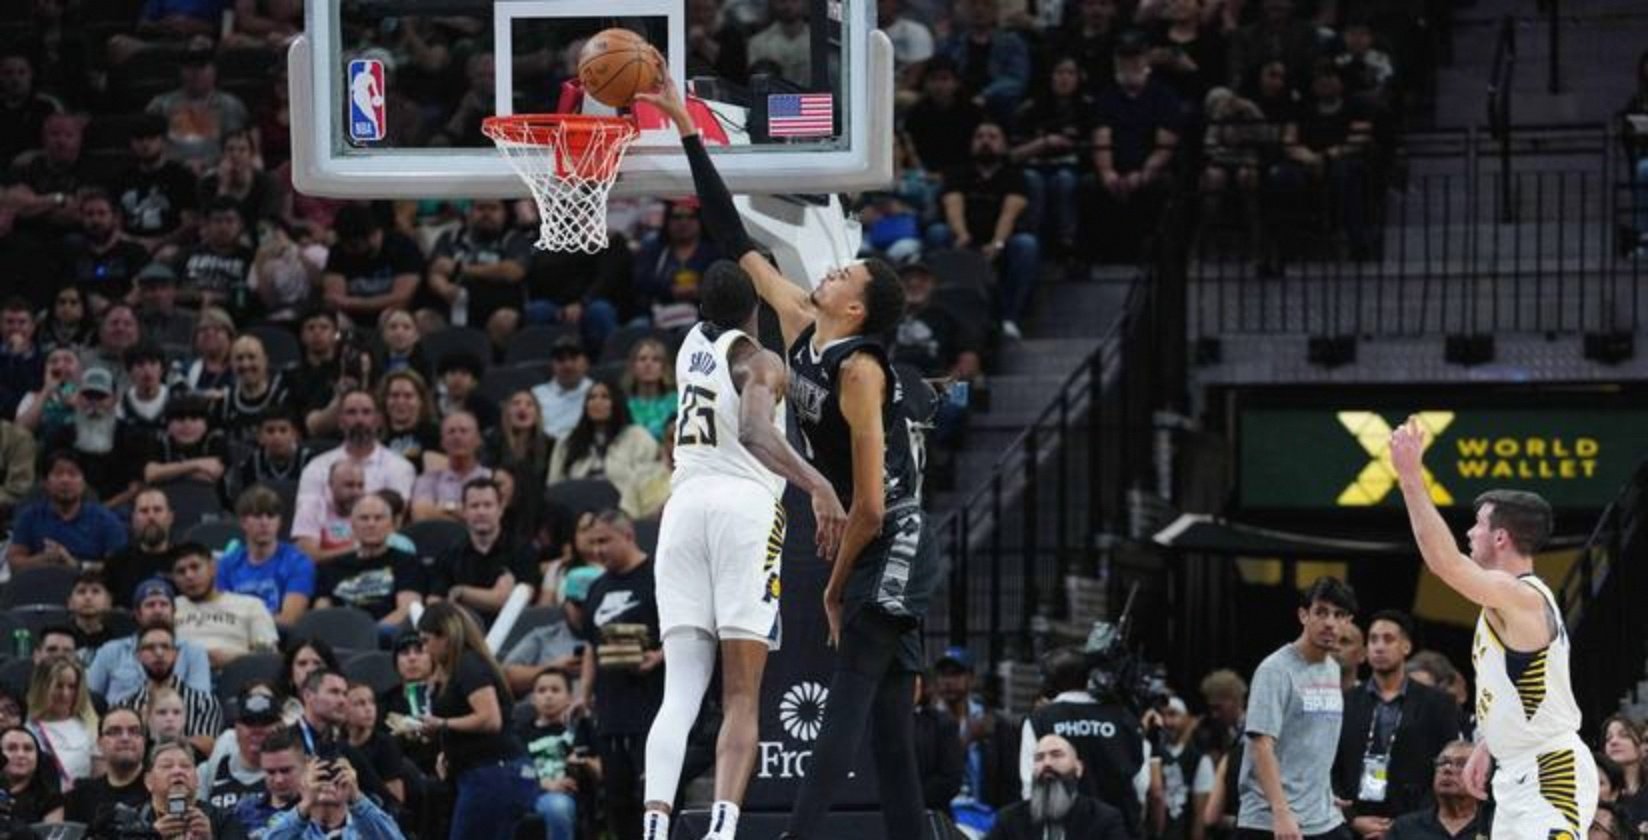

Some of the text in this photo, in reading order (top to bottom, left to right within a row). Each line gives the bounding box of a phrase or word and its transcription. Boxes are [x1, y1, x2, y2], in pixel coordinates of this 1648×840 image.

[355, 122, 373, 135] NBA
[688, 351, 717, 376] SMITH
[678, 384, 717, 447] 25
[1457, 437, 1598, 458] WORLD
[1457, 459, 1596, 478] WALLET
[1054, 719, 1116, 738] PHOTO
